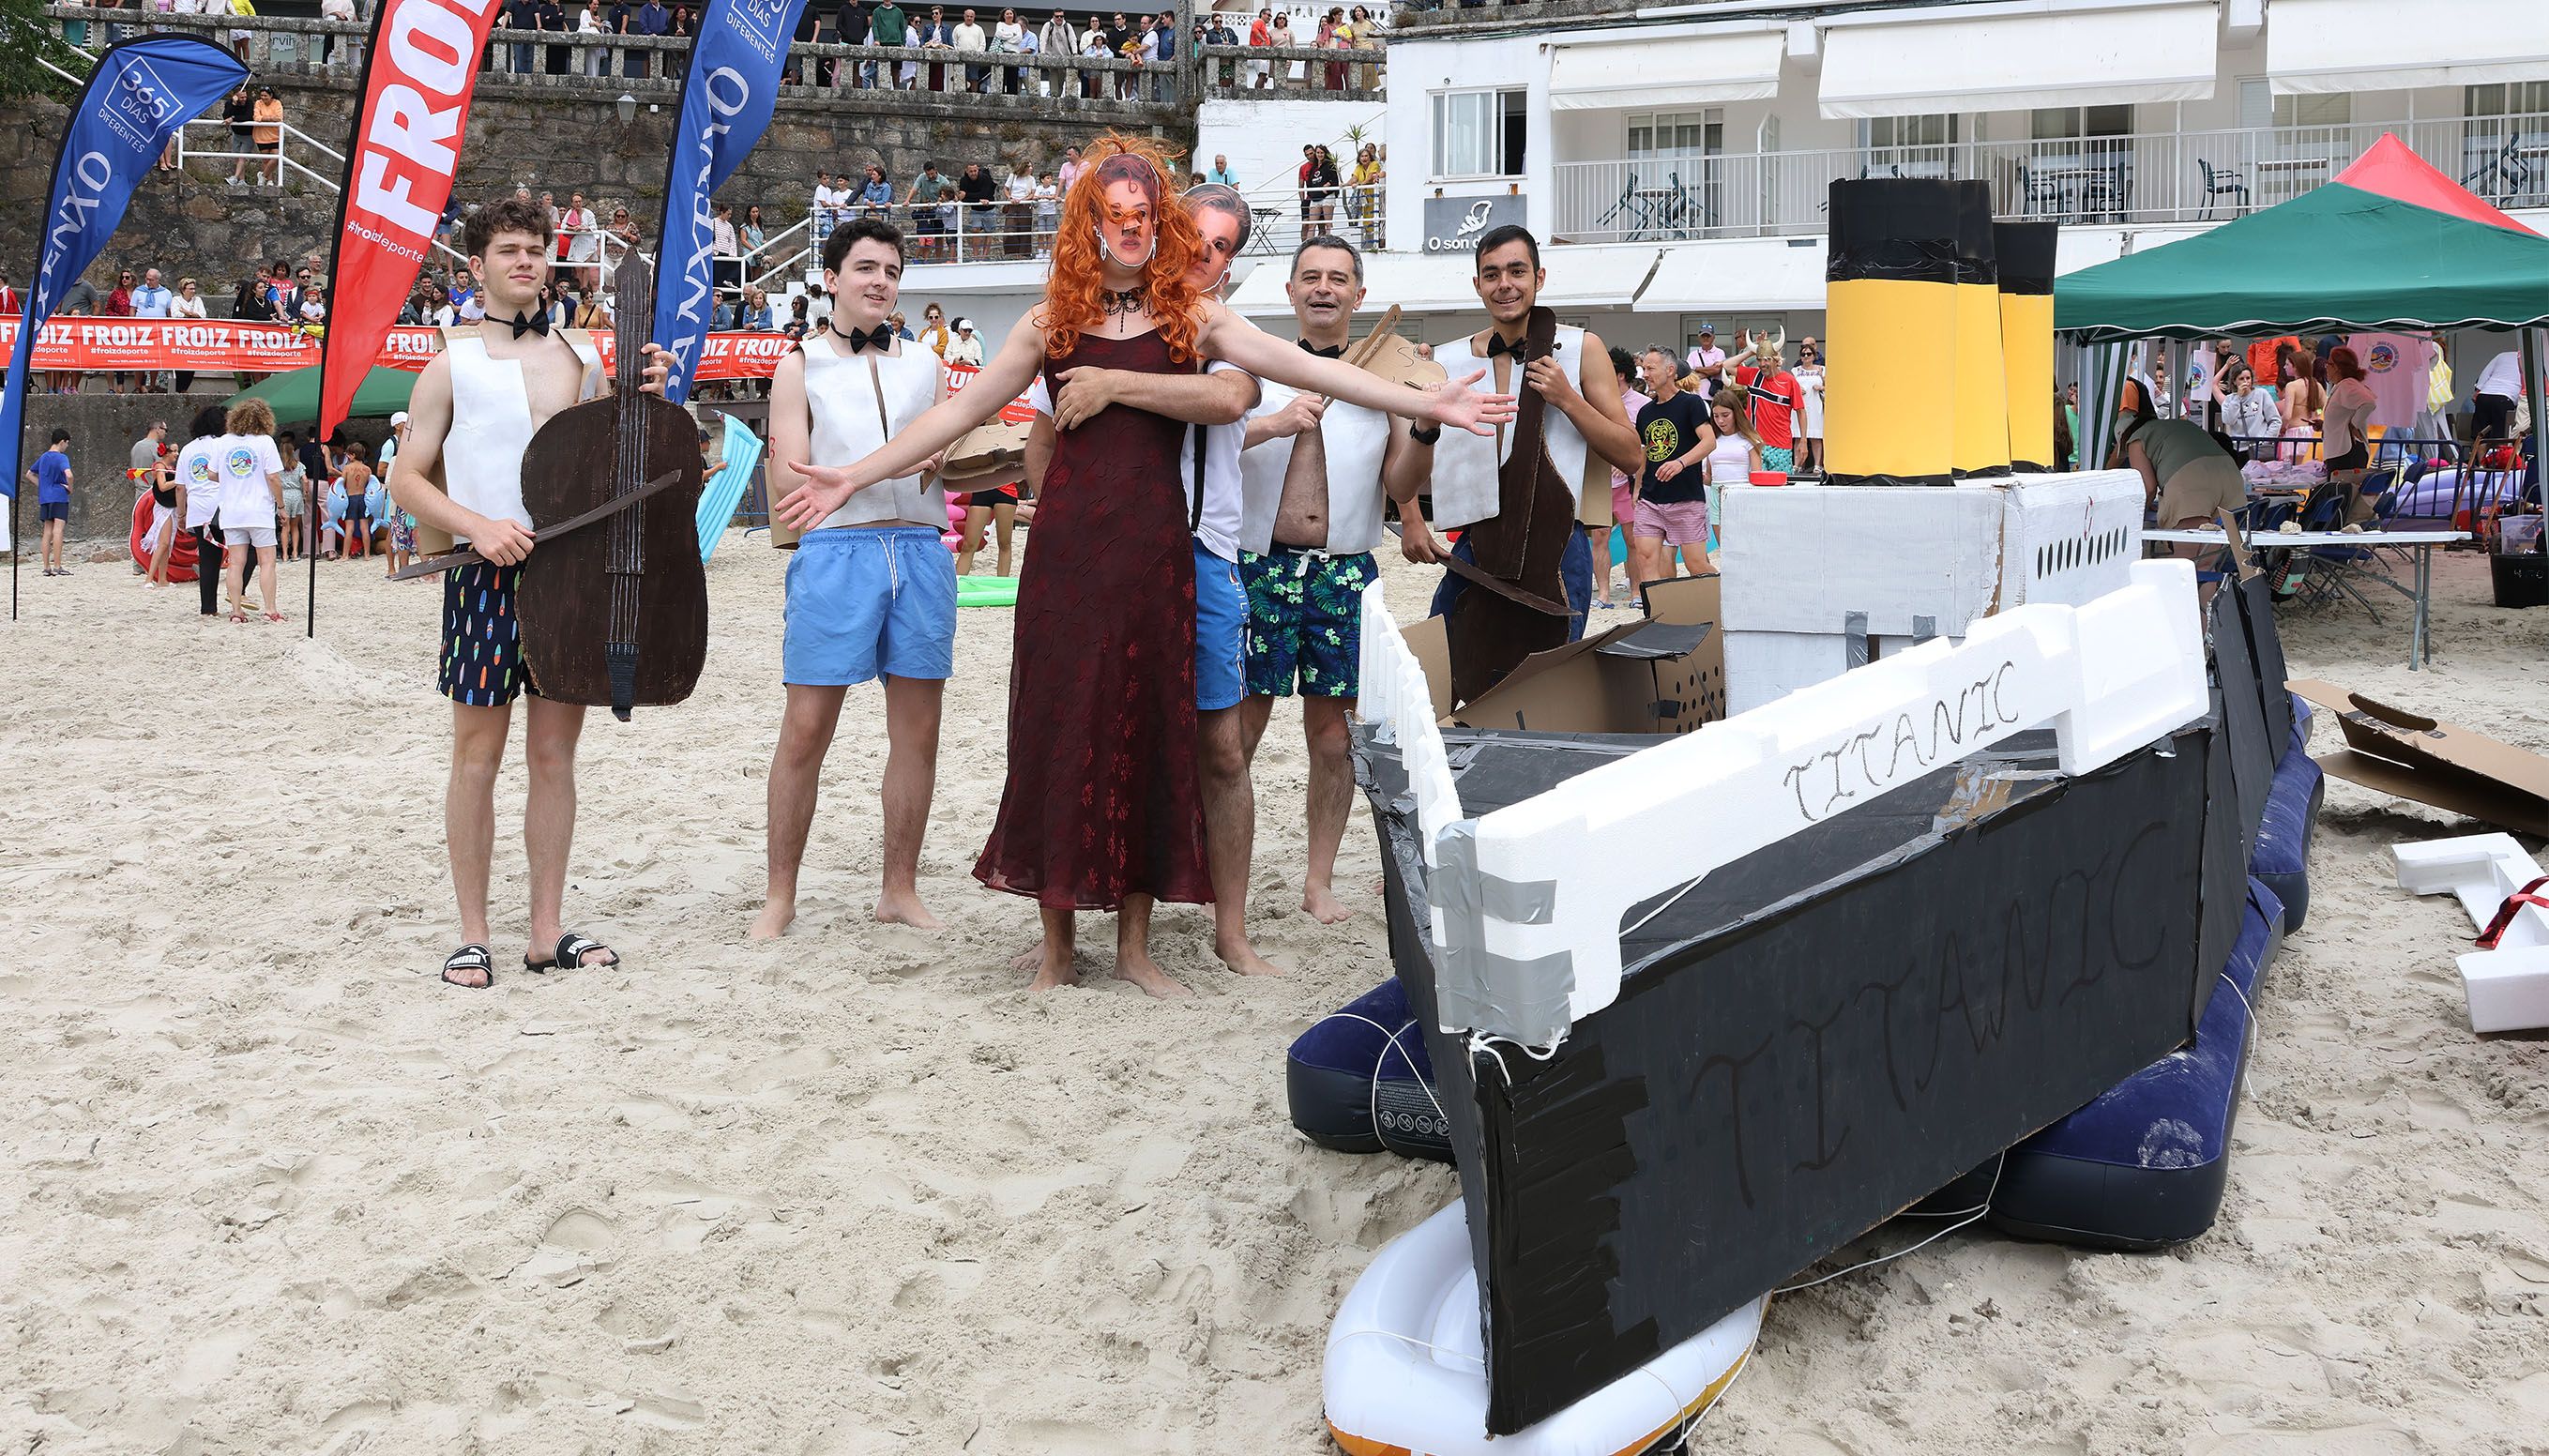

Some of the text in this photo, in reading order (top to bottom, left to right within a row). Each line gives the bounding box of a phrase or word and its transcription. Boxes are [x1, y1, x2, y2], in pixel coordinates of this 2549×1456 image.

[726, 11, 775, 64] DIFERENTES
[121, 70, 171, 119] 365
[120, 96, 150, 124] DÍAS
[356, 0, 491, 238] FRO
[98, 108, 145, 153] DIFERENTES
[1428, 235, 1483, 251] O son d
[82, 326, 155, 346] FROIZ
[160, 326, 231, 348] FROIZ
[237, 329, 307, 349] FROIZ
[386, 332, 438, 354] FROI
[90, 347, 149, 356] #froizdeporte
[171, 348, 226, 356] #froizdeporte
[735, 339, 797, 356] FROIZ
[1783, 660, 2020, 823] TITANIC
[446, 954, 482, 967] PUMA
[1690, 821, 2167, 1210] TITANIC
